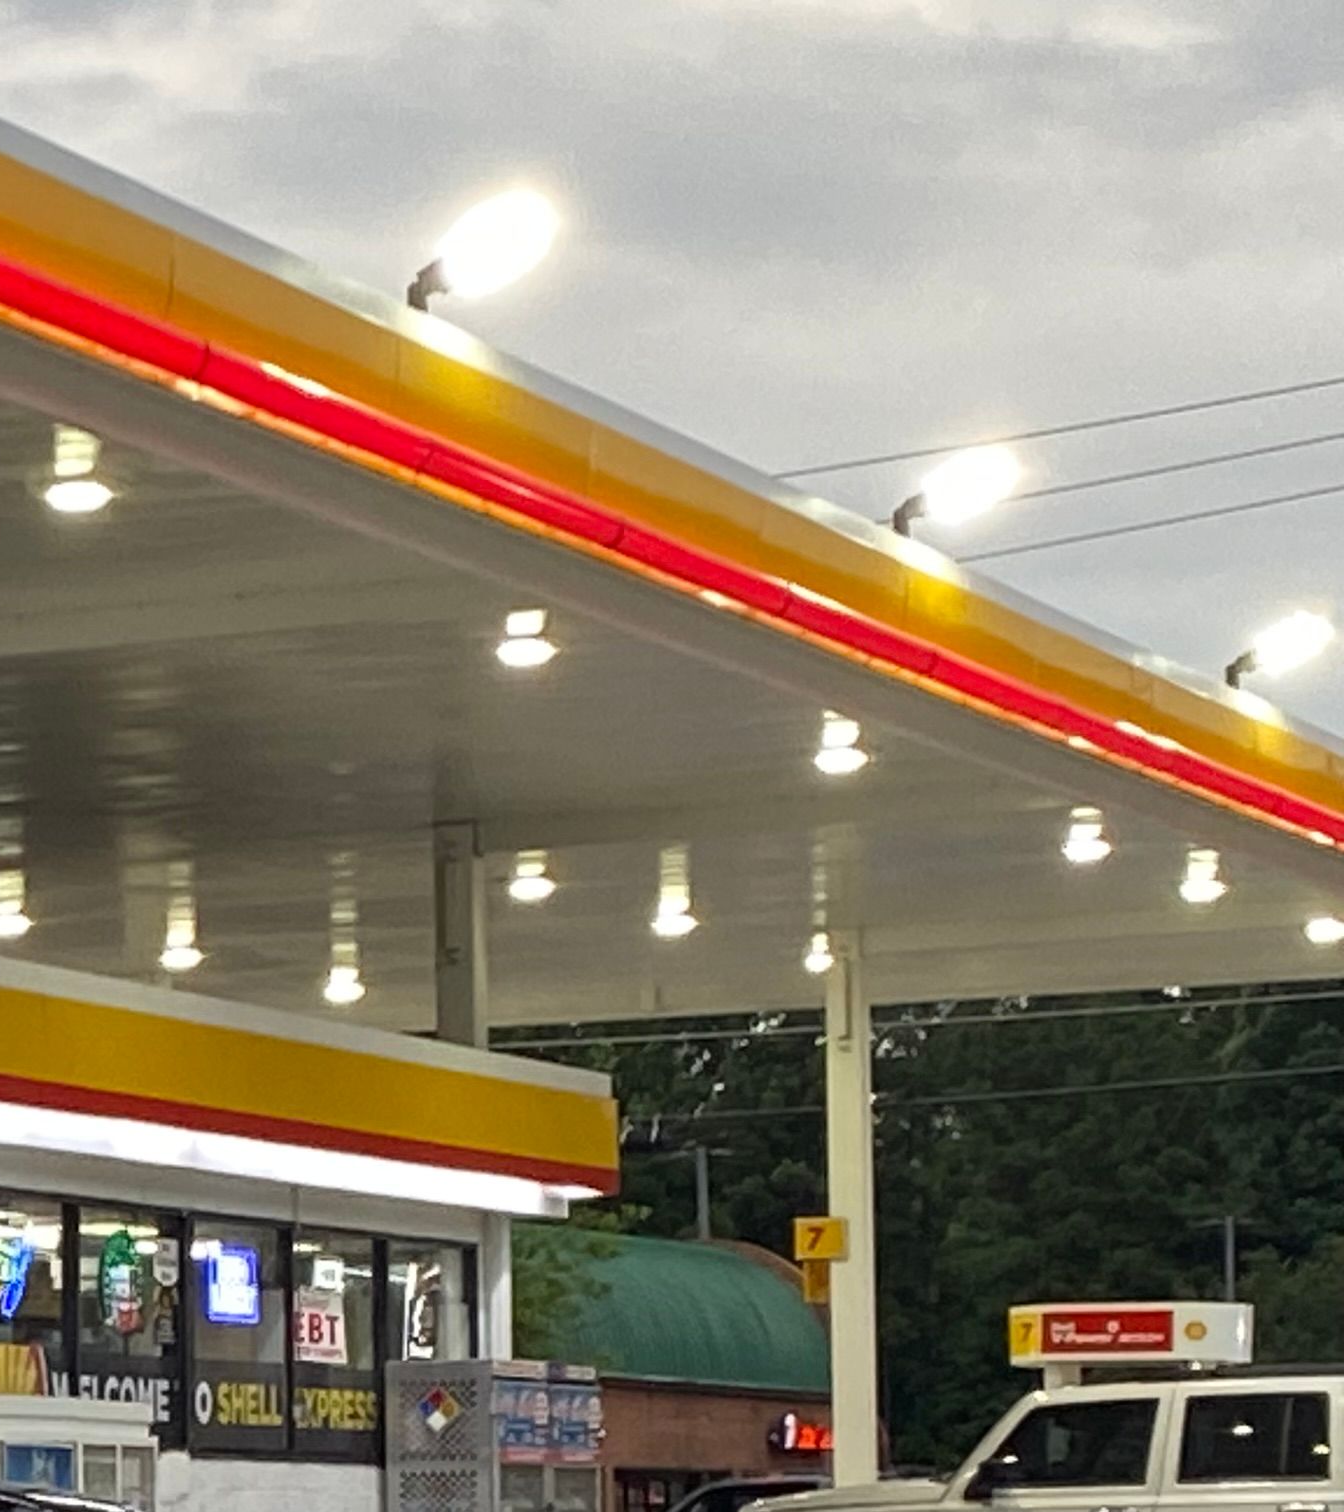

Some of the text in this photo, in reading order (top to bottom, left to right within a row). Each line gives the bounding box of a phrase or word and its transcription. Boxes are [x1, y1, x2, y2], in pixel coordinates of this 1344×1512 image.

[807, 1226, 826, 1252] 7
[291, 1311, 340, 1346] EBT
[1020, 1322, 1033, 1342] 7
[216, 1381, 283, 1427] SHELL
